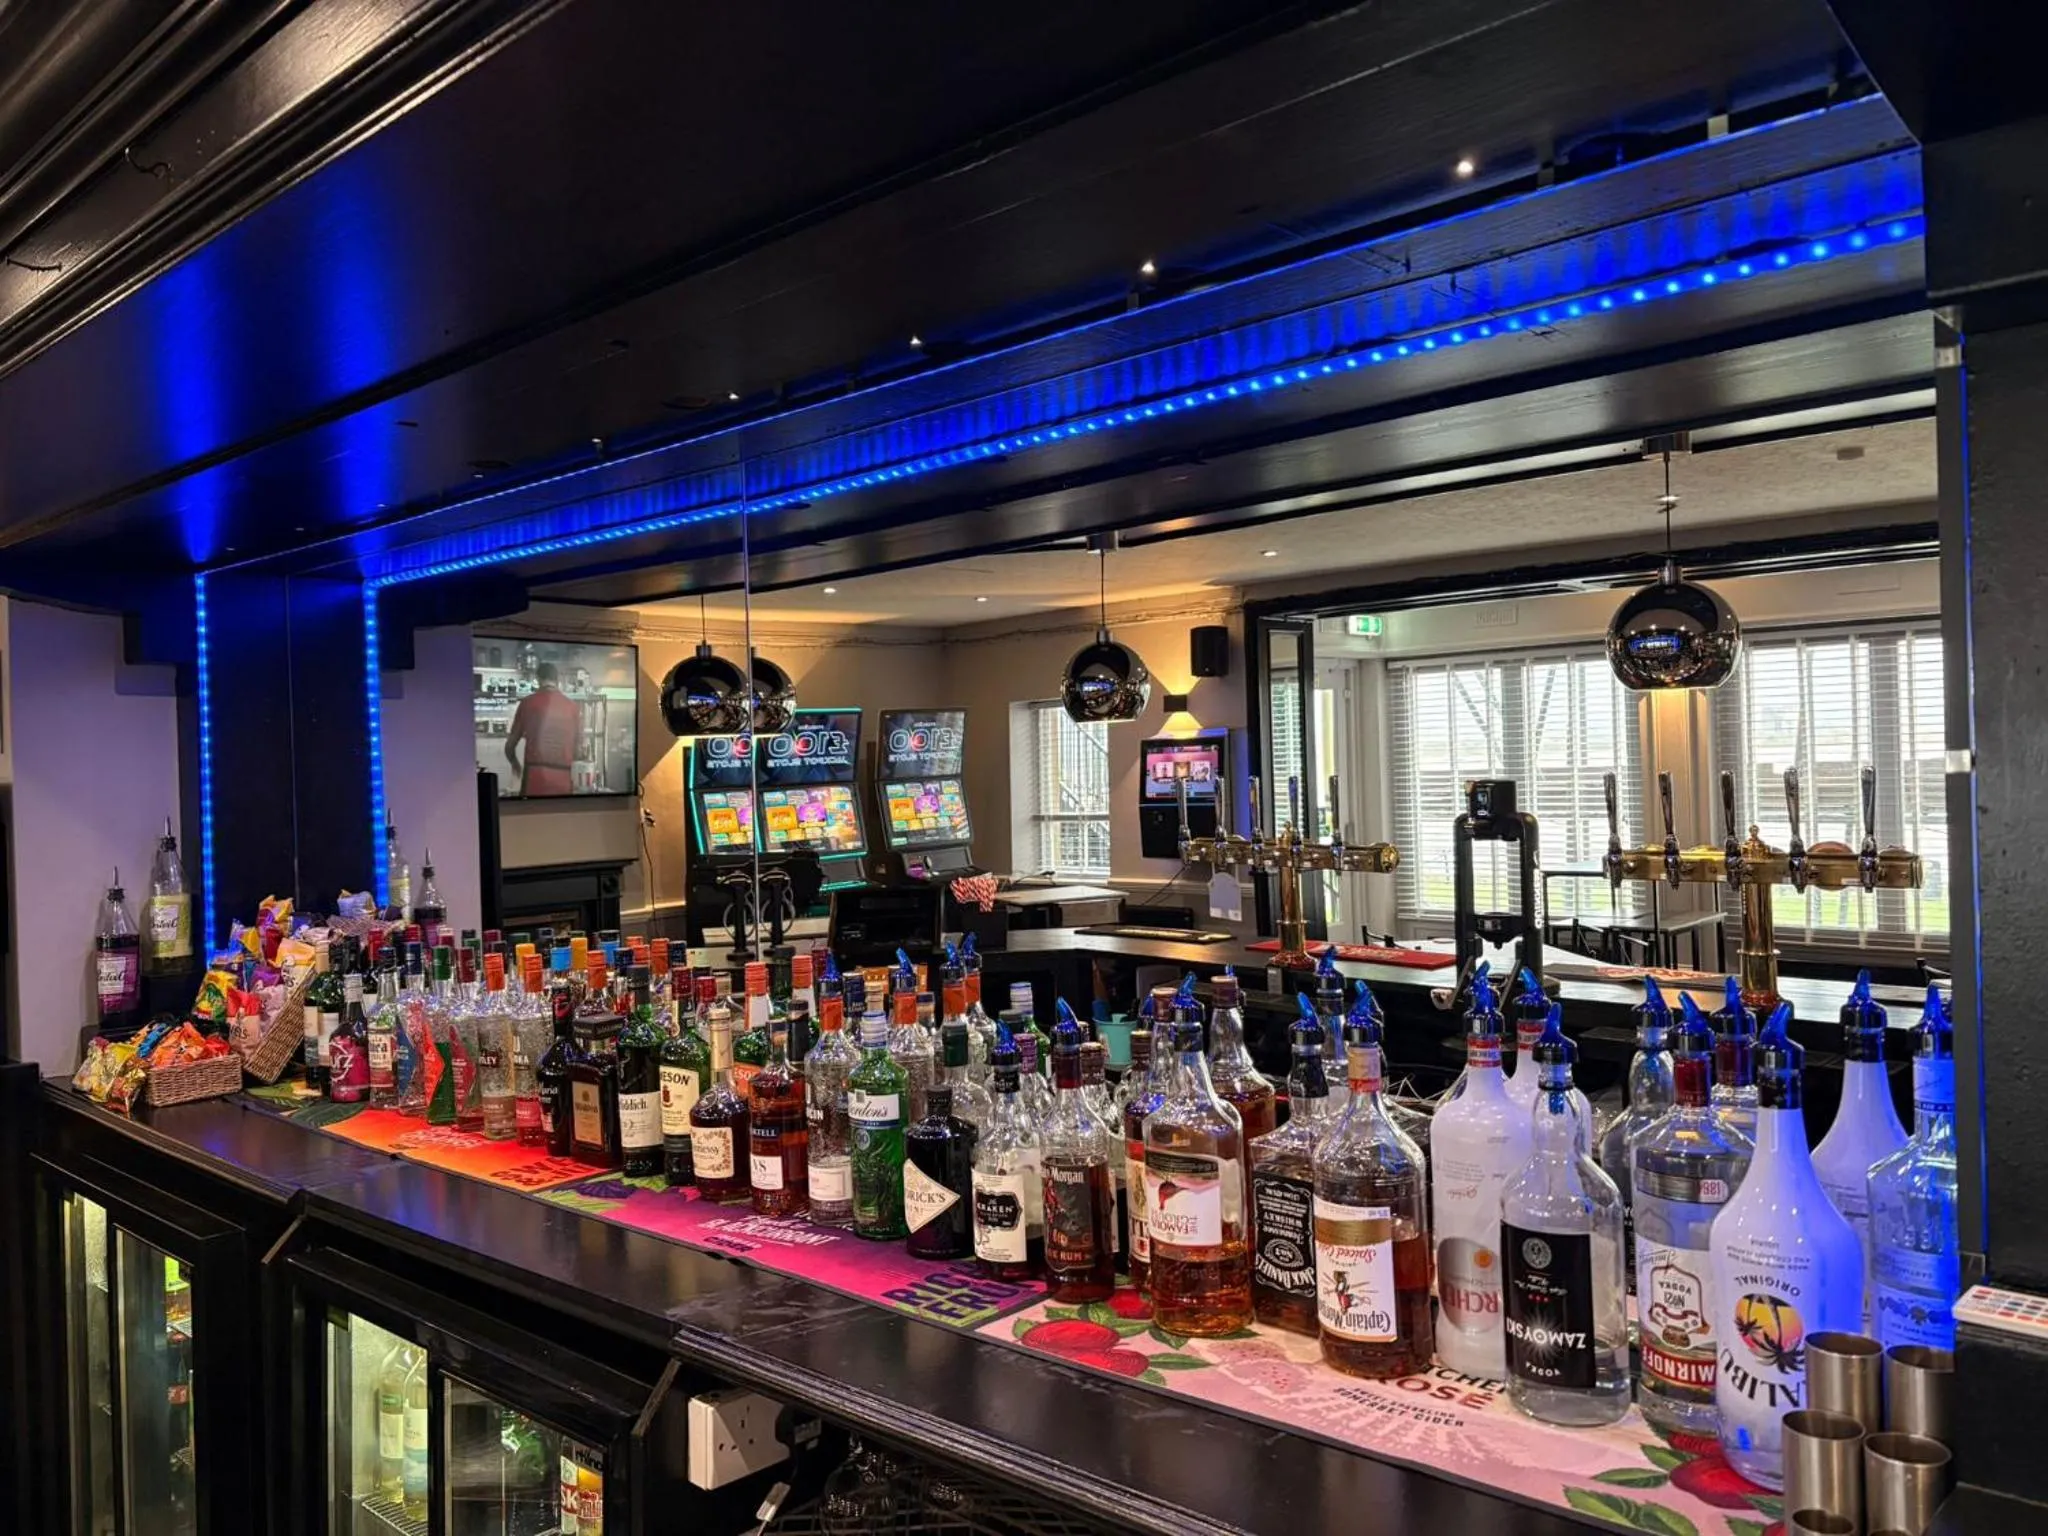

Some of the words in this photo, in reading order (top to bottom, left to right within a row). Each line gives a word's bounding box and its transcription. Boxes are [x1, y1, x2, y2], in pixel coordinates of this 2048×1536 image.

[1263, 1211, 1303, 1228] WHISKEY
[1337, 1247, 1377, 1264] Spiced
[1658, 1281, 1692, 1296] VODKA
[1734, 1275, 1801, 1297] ORIGINAL
[1346, 1311, 1391, 1333] Captain
[1506, 1316, 1587, 1349] ZAMOYSKI
[1525, 1361, 1562, 1377] VODKA
[1642, 1346, 1716, 1382] MIRNOFF
[1720, 1349, 1806, 1409] ALIBU
[1412, 1413, 1465, 1428] CIDER
